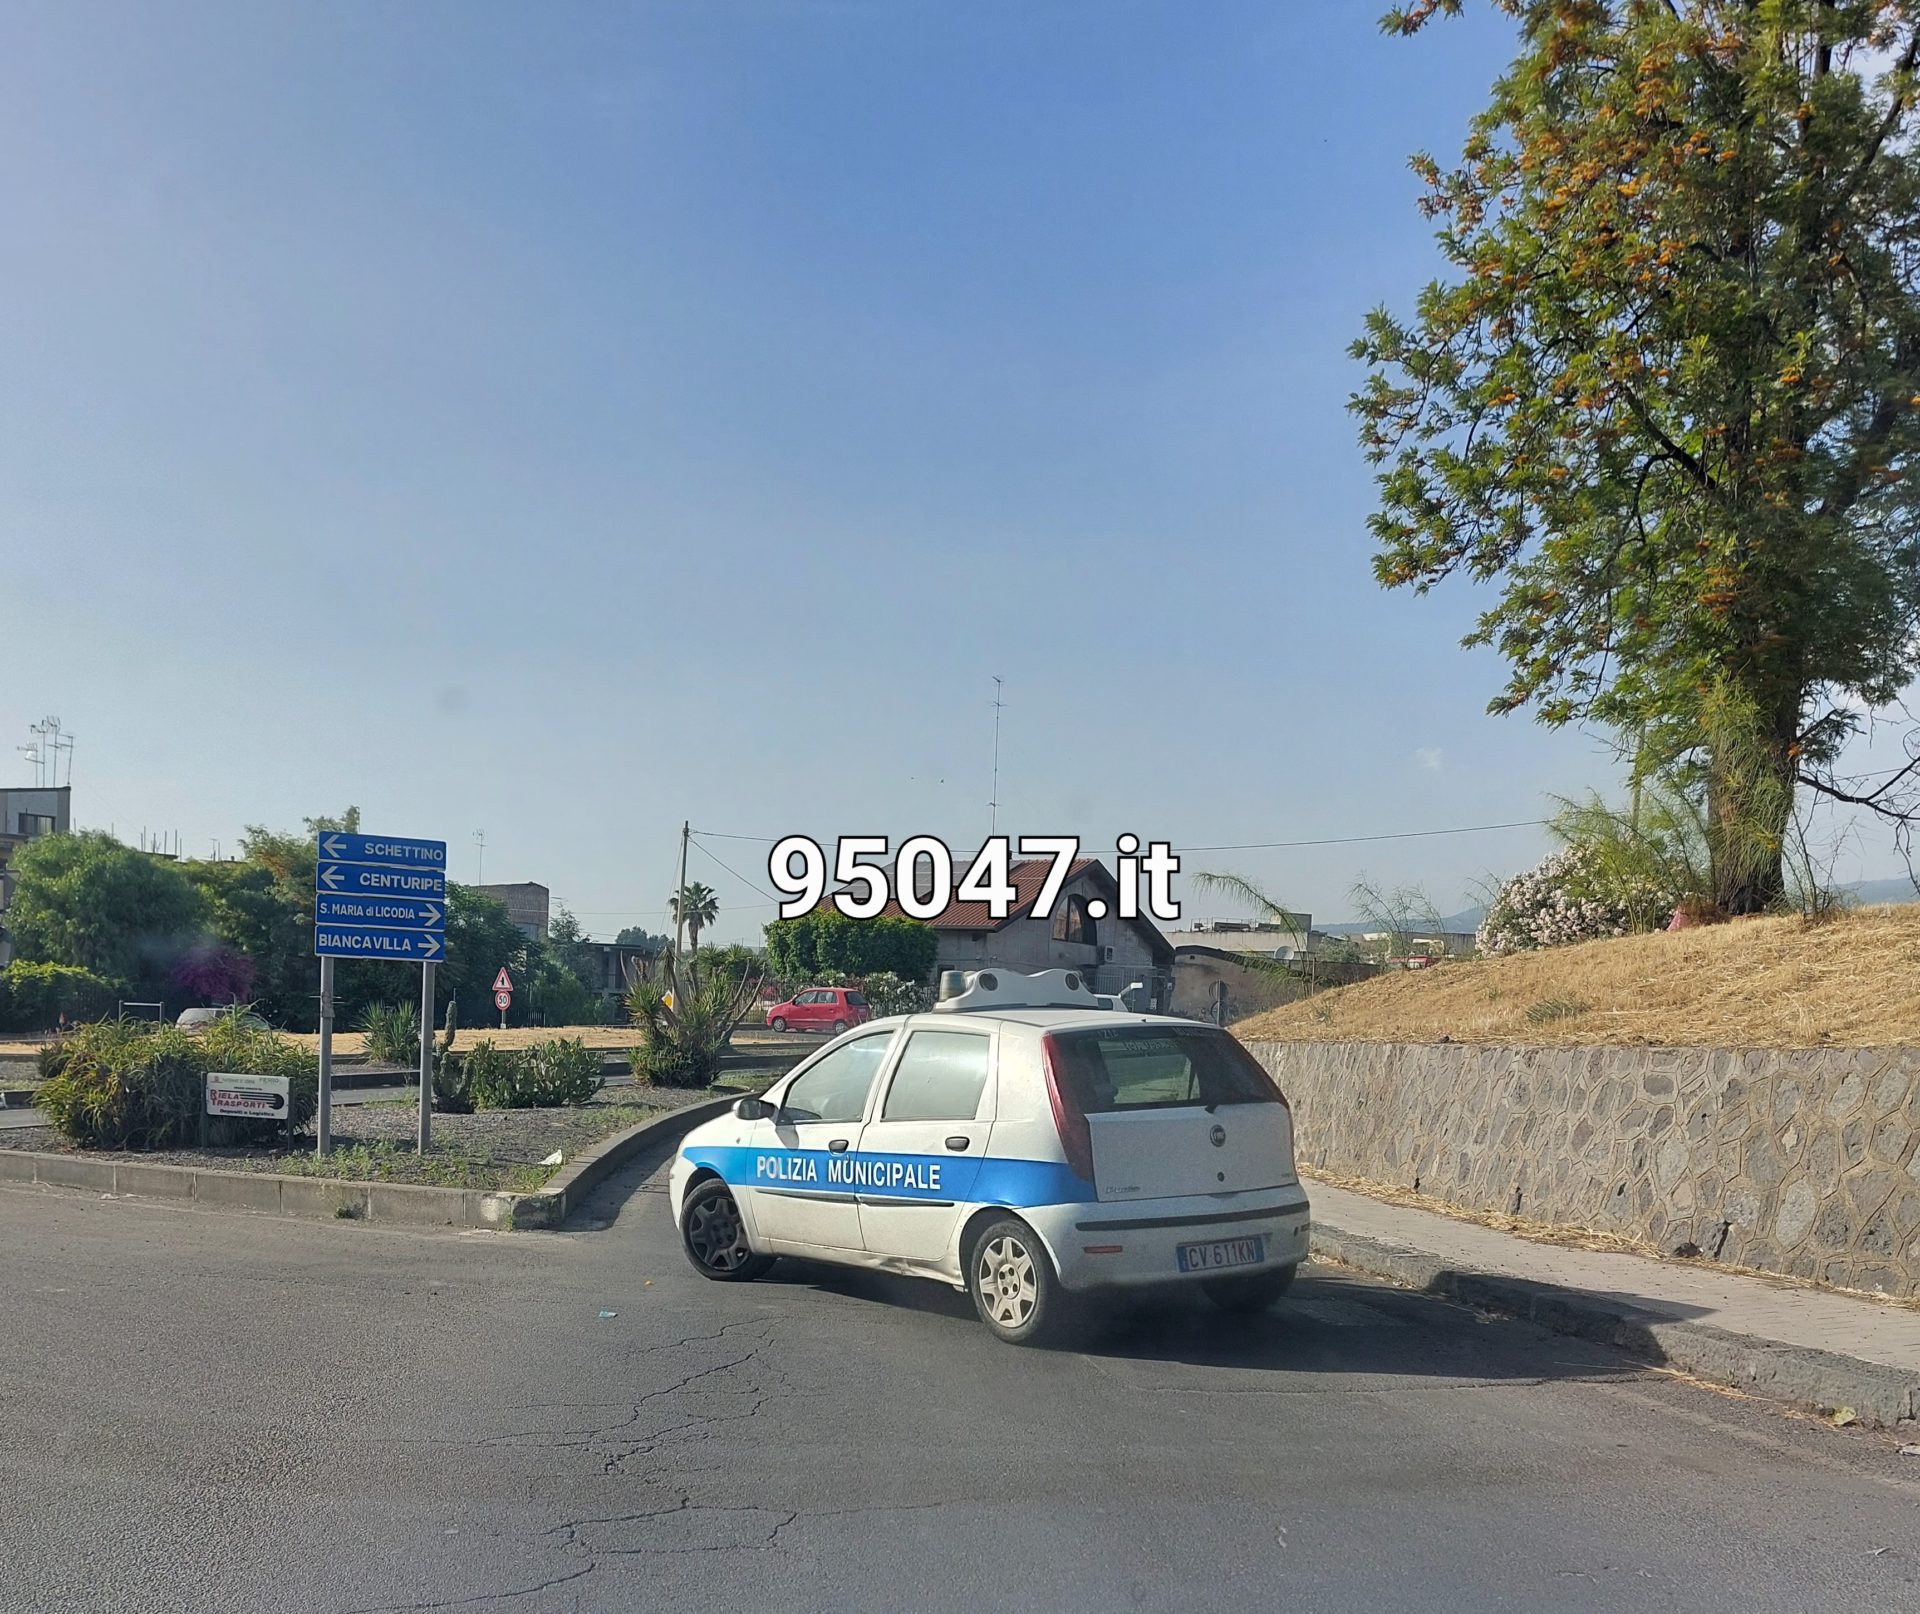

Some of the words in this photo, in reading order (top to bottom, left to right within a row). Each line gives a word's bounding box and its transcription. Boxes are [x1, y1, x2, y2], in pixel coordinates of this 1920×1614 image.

[364, 843, 444, 861] SCHETTINO
[359, 872, 443, 891] CENTURIPE
[319, 902, 331, 914] S.
[331, 903, 363, 917] MARIA
[366, 906, 374, 917] di
[375, 906, 415, 919] LICODIA
[318, 933, 411, 951] BIANCAVILLA
[498, 995, 507, 1004] 50
[210, 1089, 239, 1100] RIELA
[211, 1099, 266, 1109] TRASPORTI
[756, 1155, 817, 1182] POLIZIA
[828, 1159, 941, 1190] MUNICIPALE
[1188, 1246, 1207, 1268] CV
